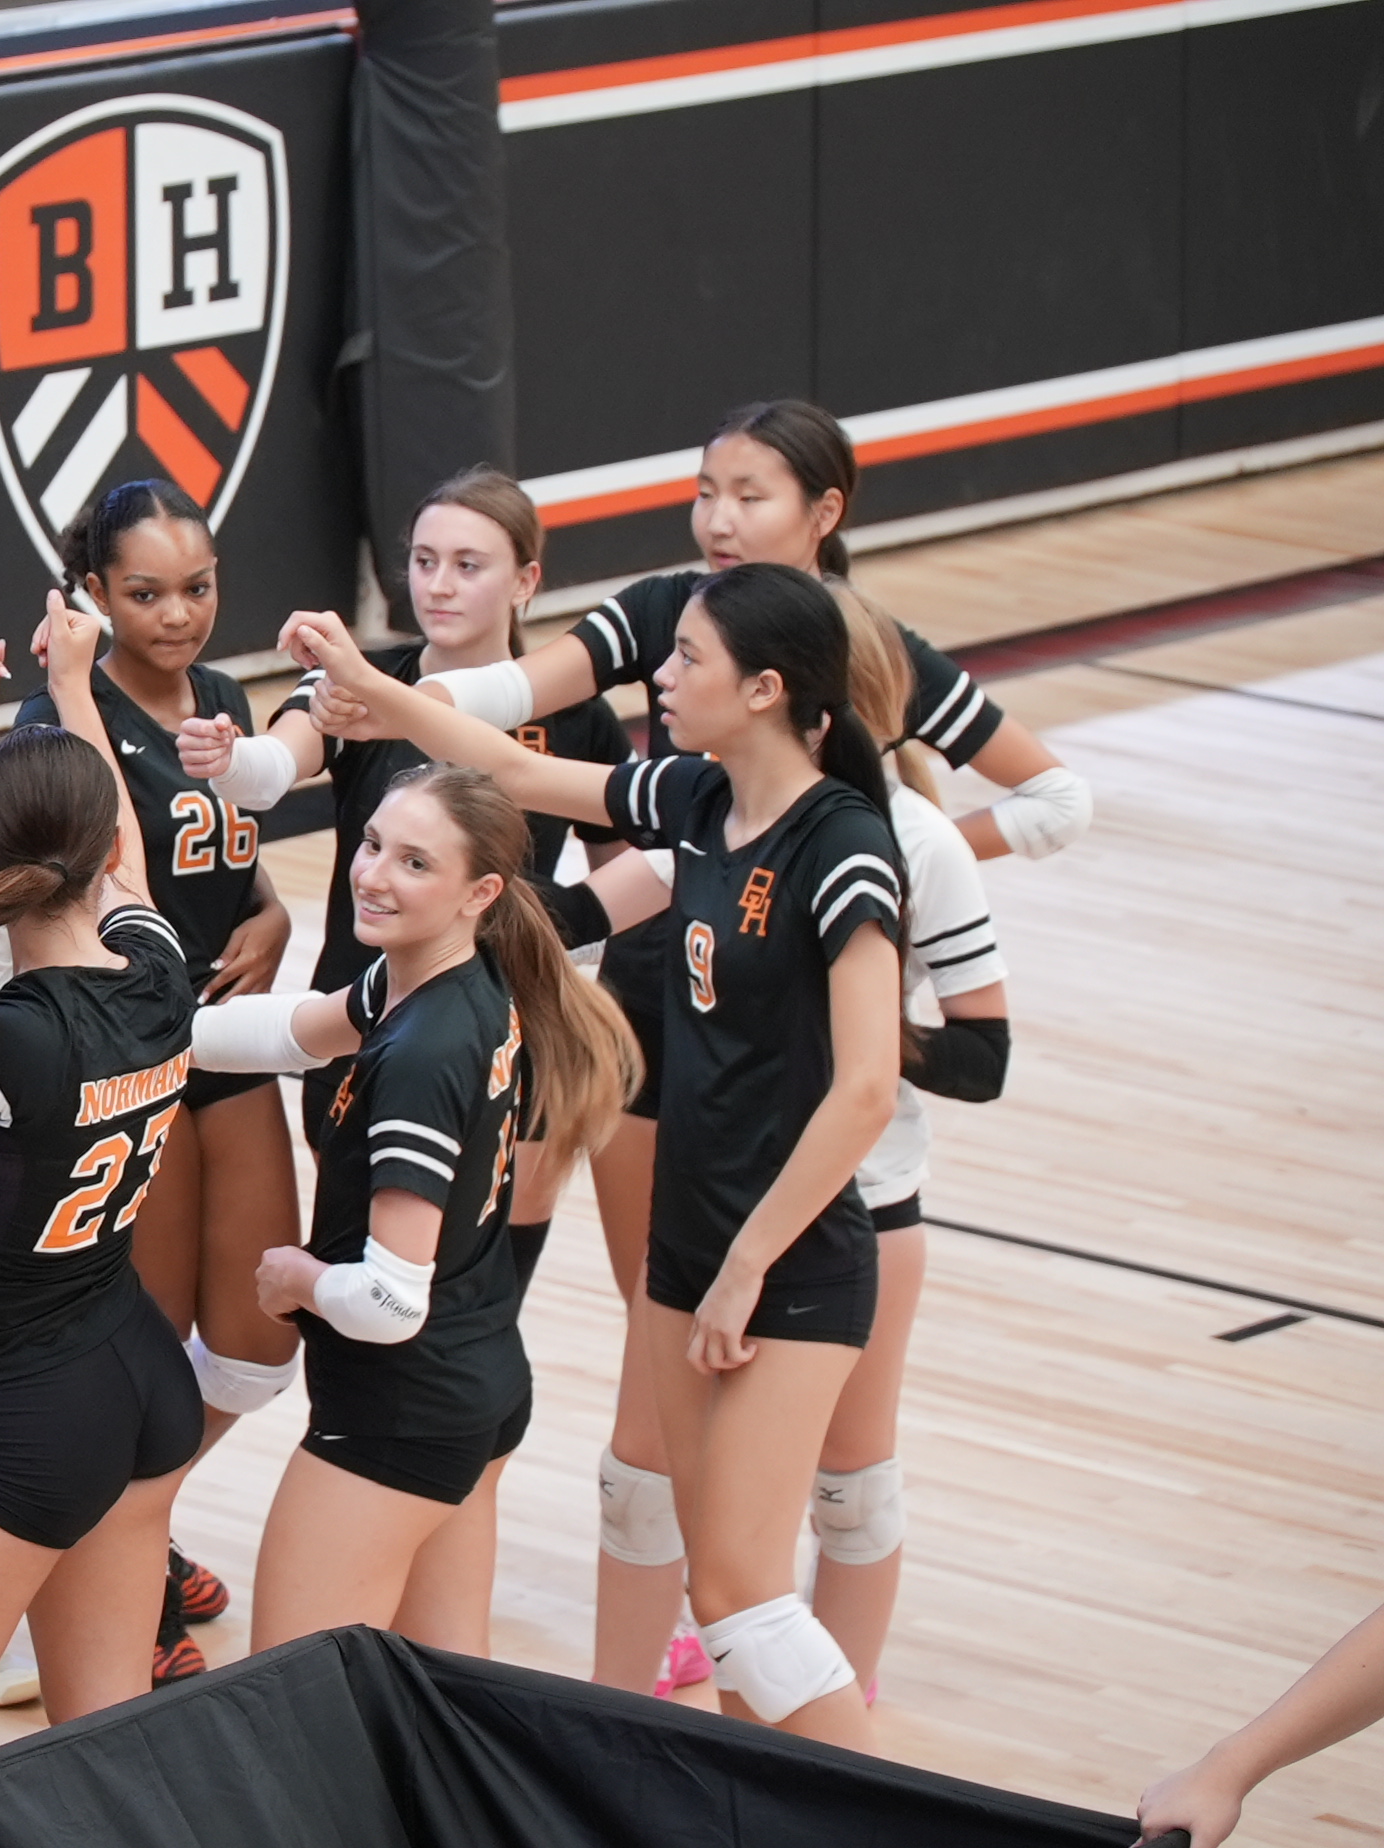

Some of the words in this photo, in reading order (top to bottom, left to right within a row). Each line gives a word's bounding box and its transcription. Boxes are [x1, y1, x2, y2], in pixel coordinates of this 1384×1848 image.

[169, 790, 259, 876] 26
[684, 919, 716, 1014] 9
[74, 1046, 193, 1127] NORMAN
[32, 1099, 181, 1254] 27
